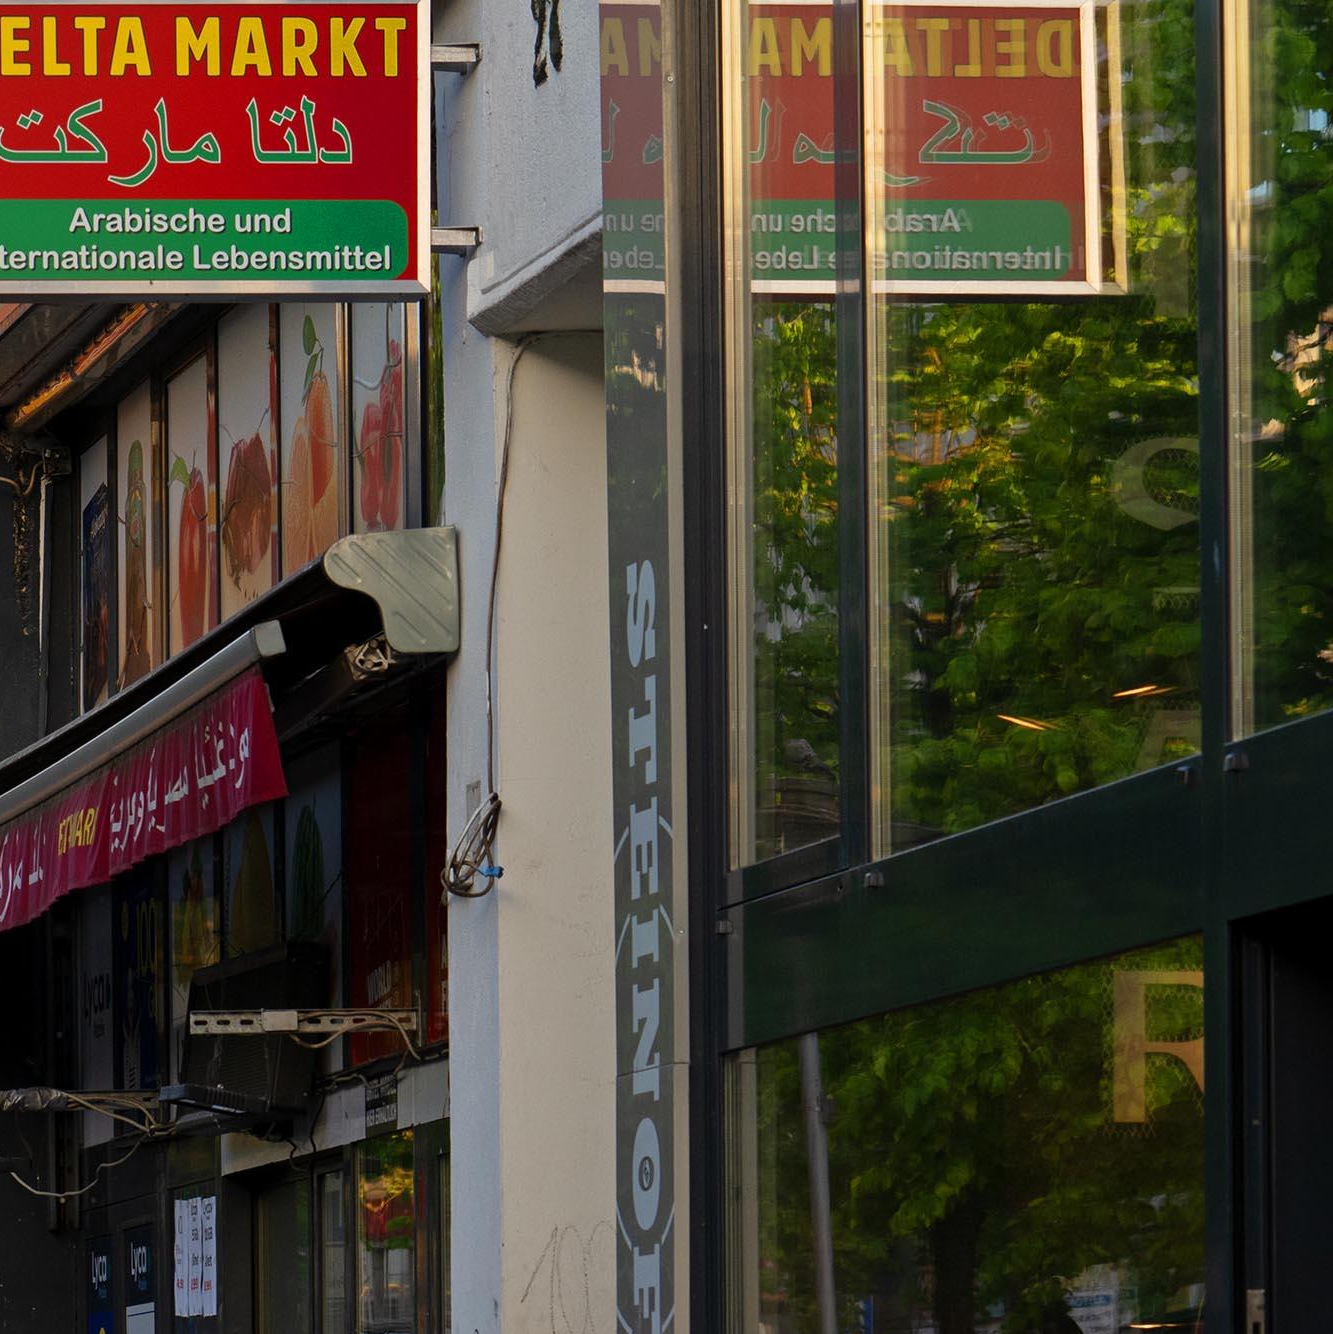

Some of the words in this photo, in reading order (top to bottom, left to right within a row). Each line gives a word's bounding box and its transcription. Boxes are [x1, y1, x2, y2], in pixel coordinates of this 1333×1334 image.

[176, 15, 408, 77] MARKT
[245, 95, 354, 167] دلتا
[68, 207, 226, 234] Arabische
[234, 207, 292, 234] und
[192, 244, 393, 272] Lebensmittel
